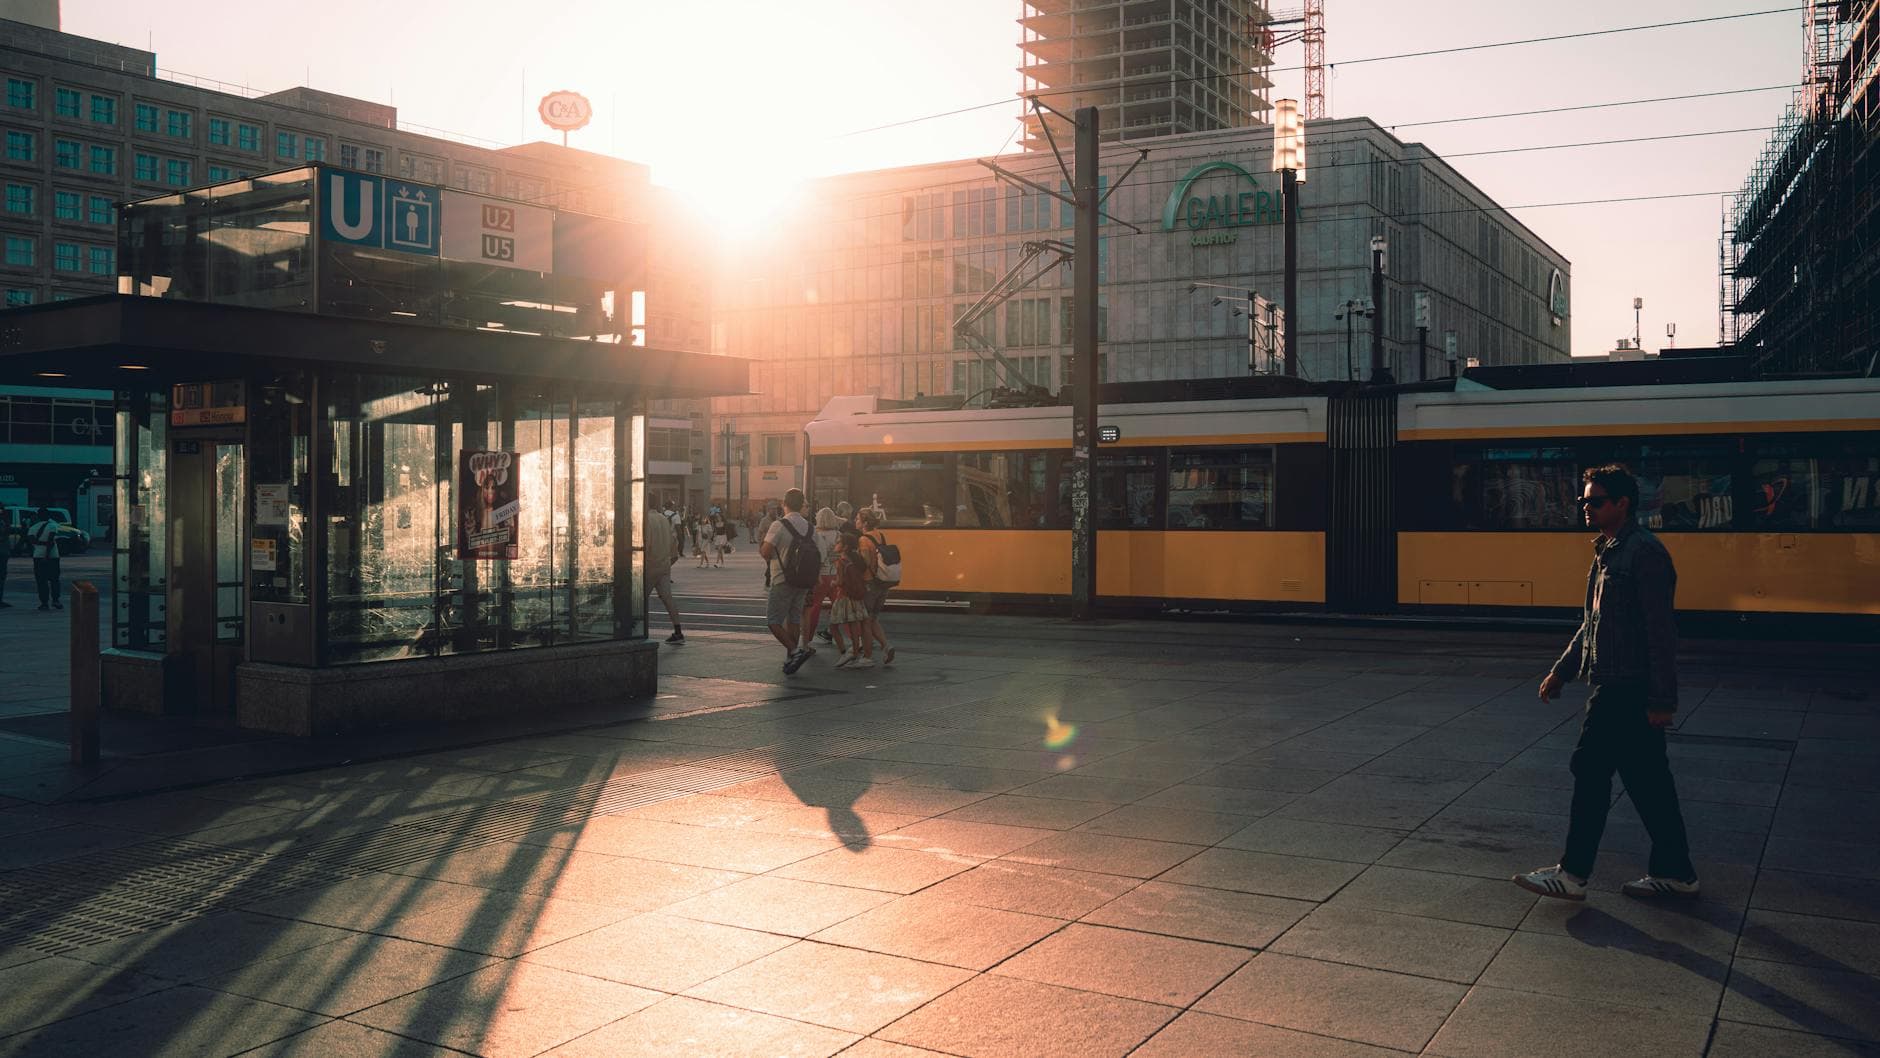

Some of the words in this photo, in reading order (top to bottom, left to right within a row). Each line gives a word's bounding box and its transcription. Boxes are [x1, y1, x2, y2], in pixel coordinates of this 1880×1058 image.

[549, 101, 581, 118] C&A
[331, 174, 374, 241] U
[1186, 189, 1302, 230] GALERI
[485, 208, 512, 230] U2
[485, 236, 512, 259] U5
[471, 453, 508, 472] WHY?
